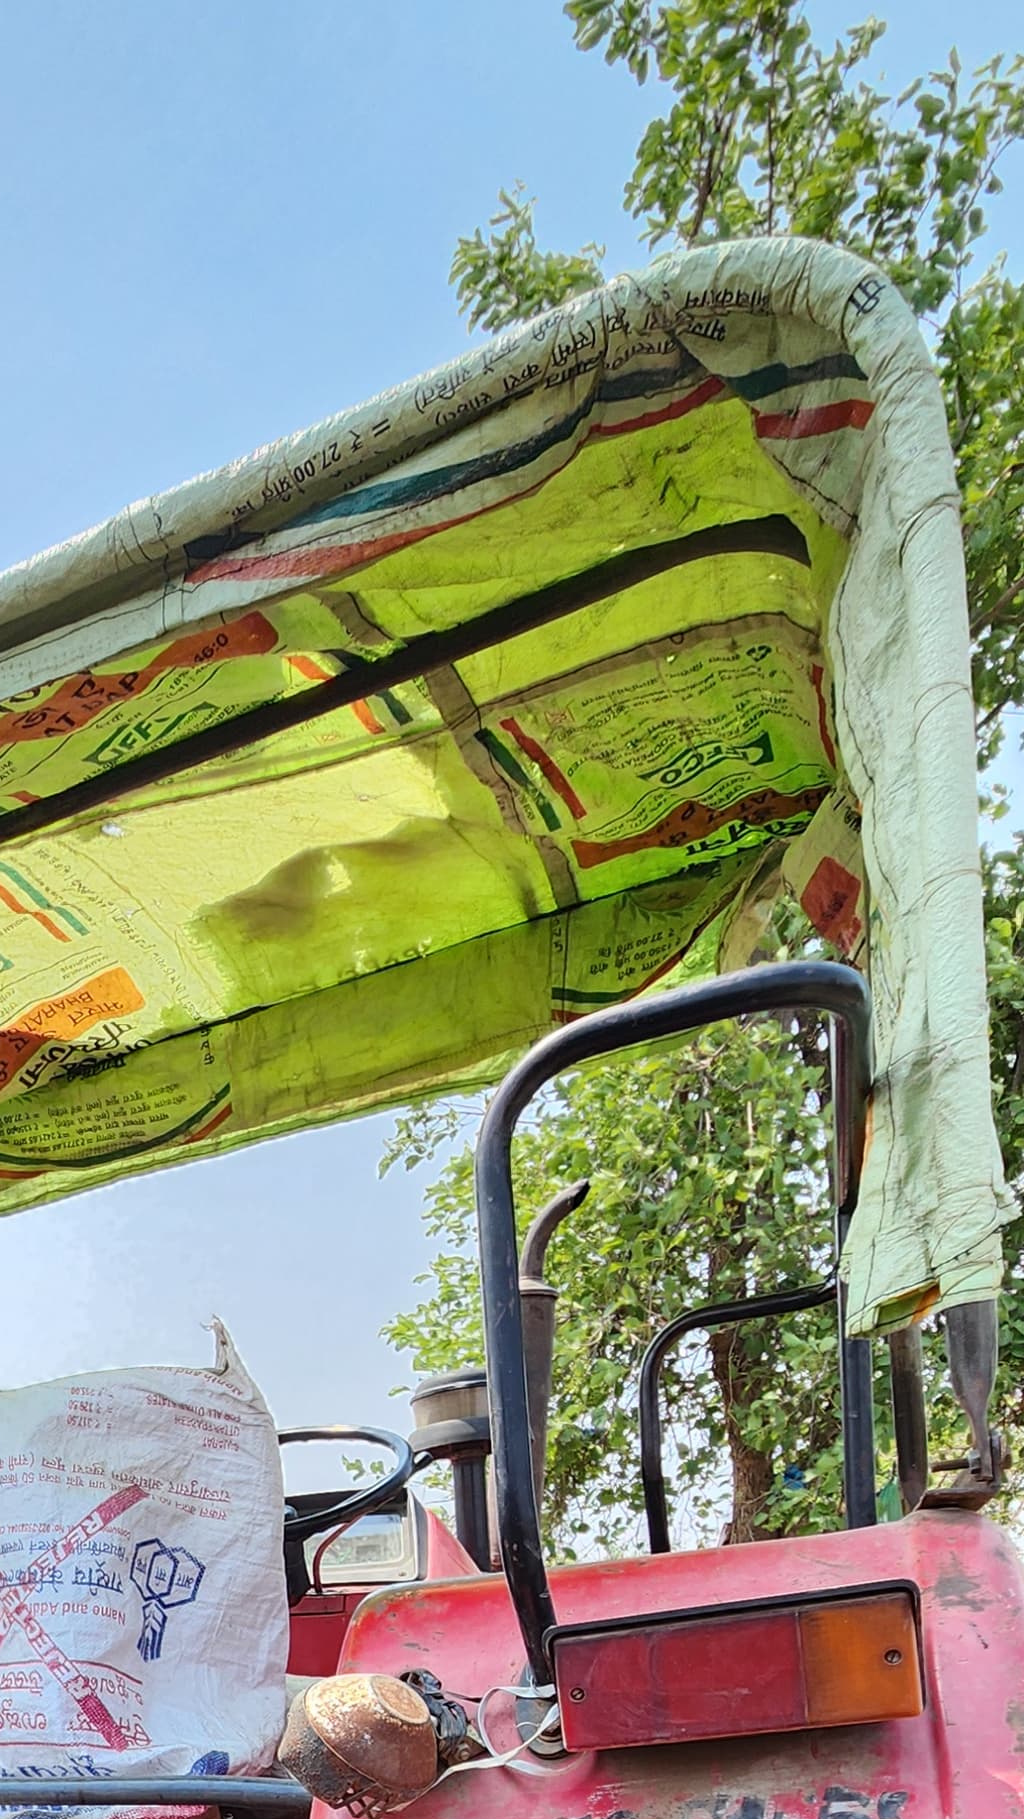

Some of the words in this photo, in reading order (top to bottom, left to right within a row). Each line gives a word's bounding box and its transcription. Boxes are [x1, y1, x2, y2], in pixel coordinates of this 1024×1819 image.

[22, 991, 93, 1031] BHARAT
[62, 1602, 88, 1615] and
[92, 1604, 125, 1625] Name
